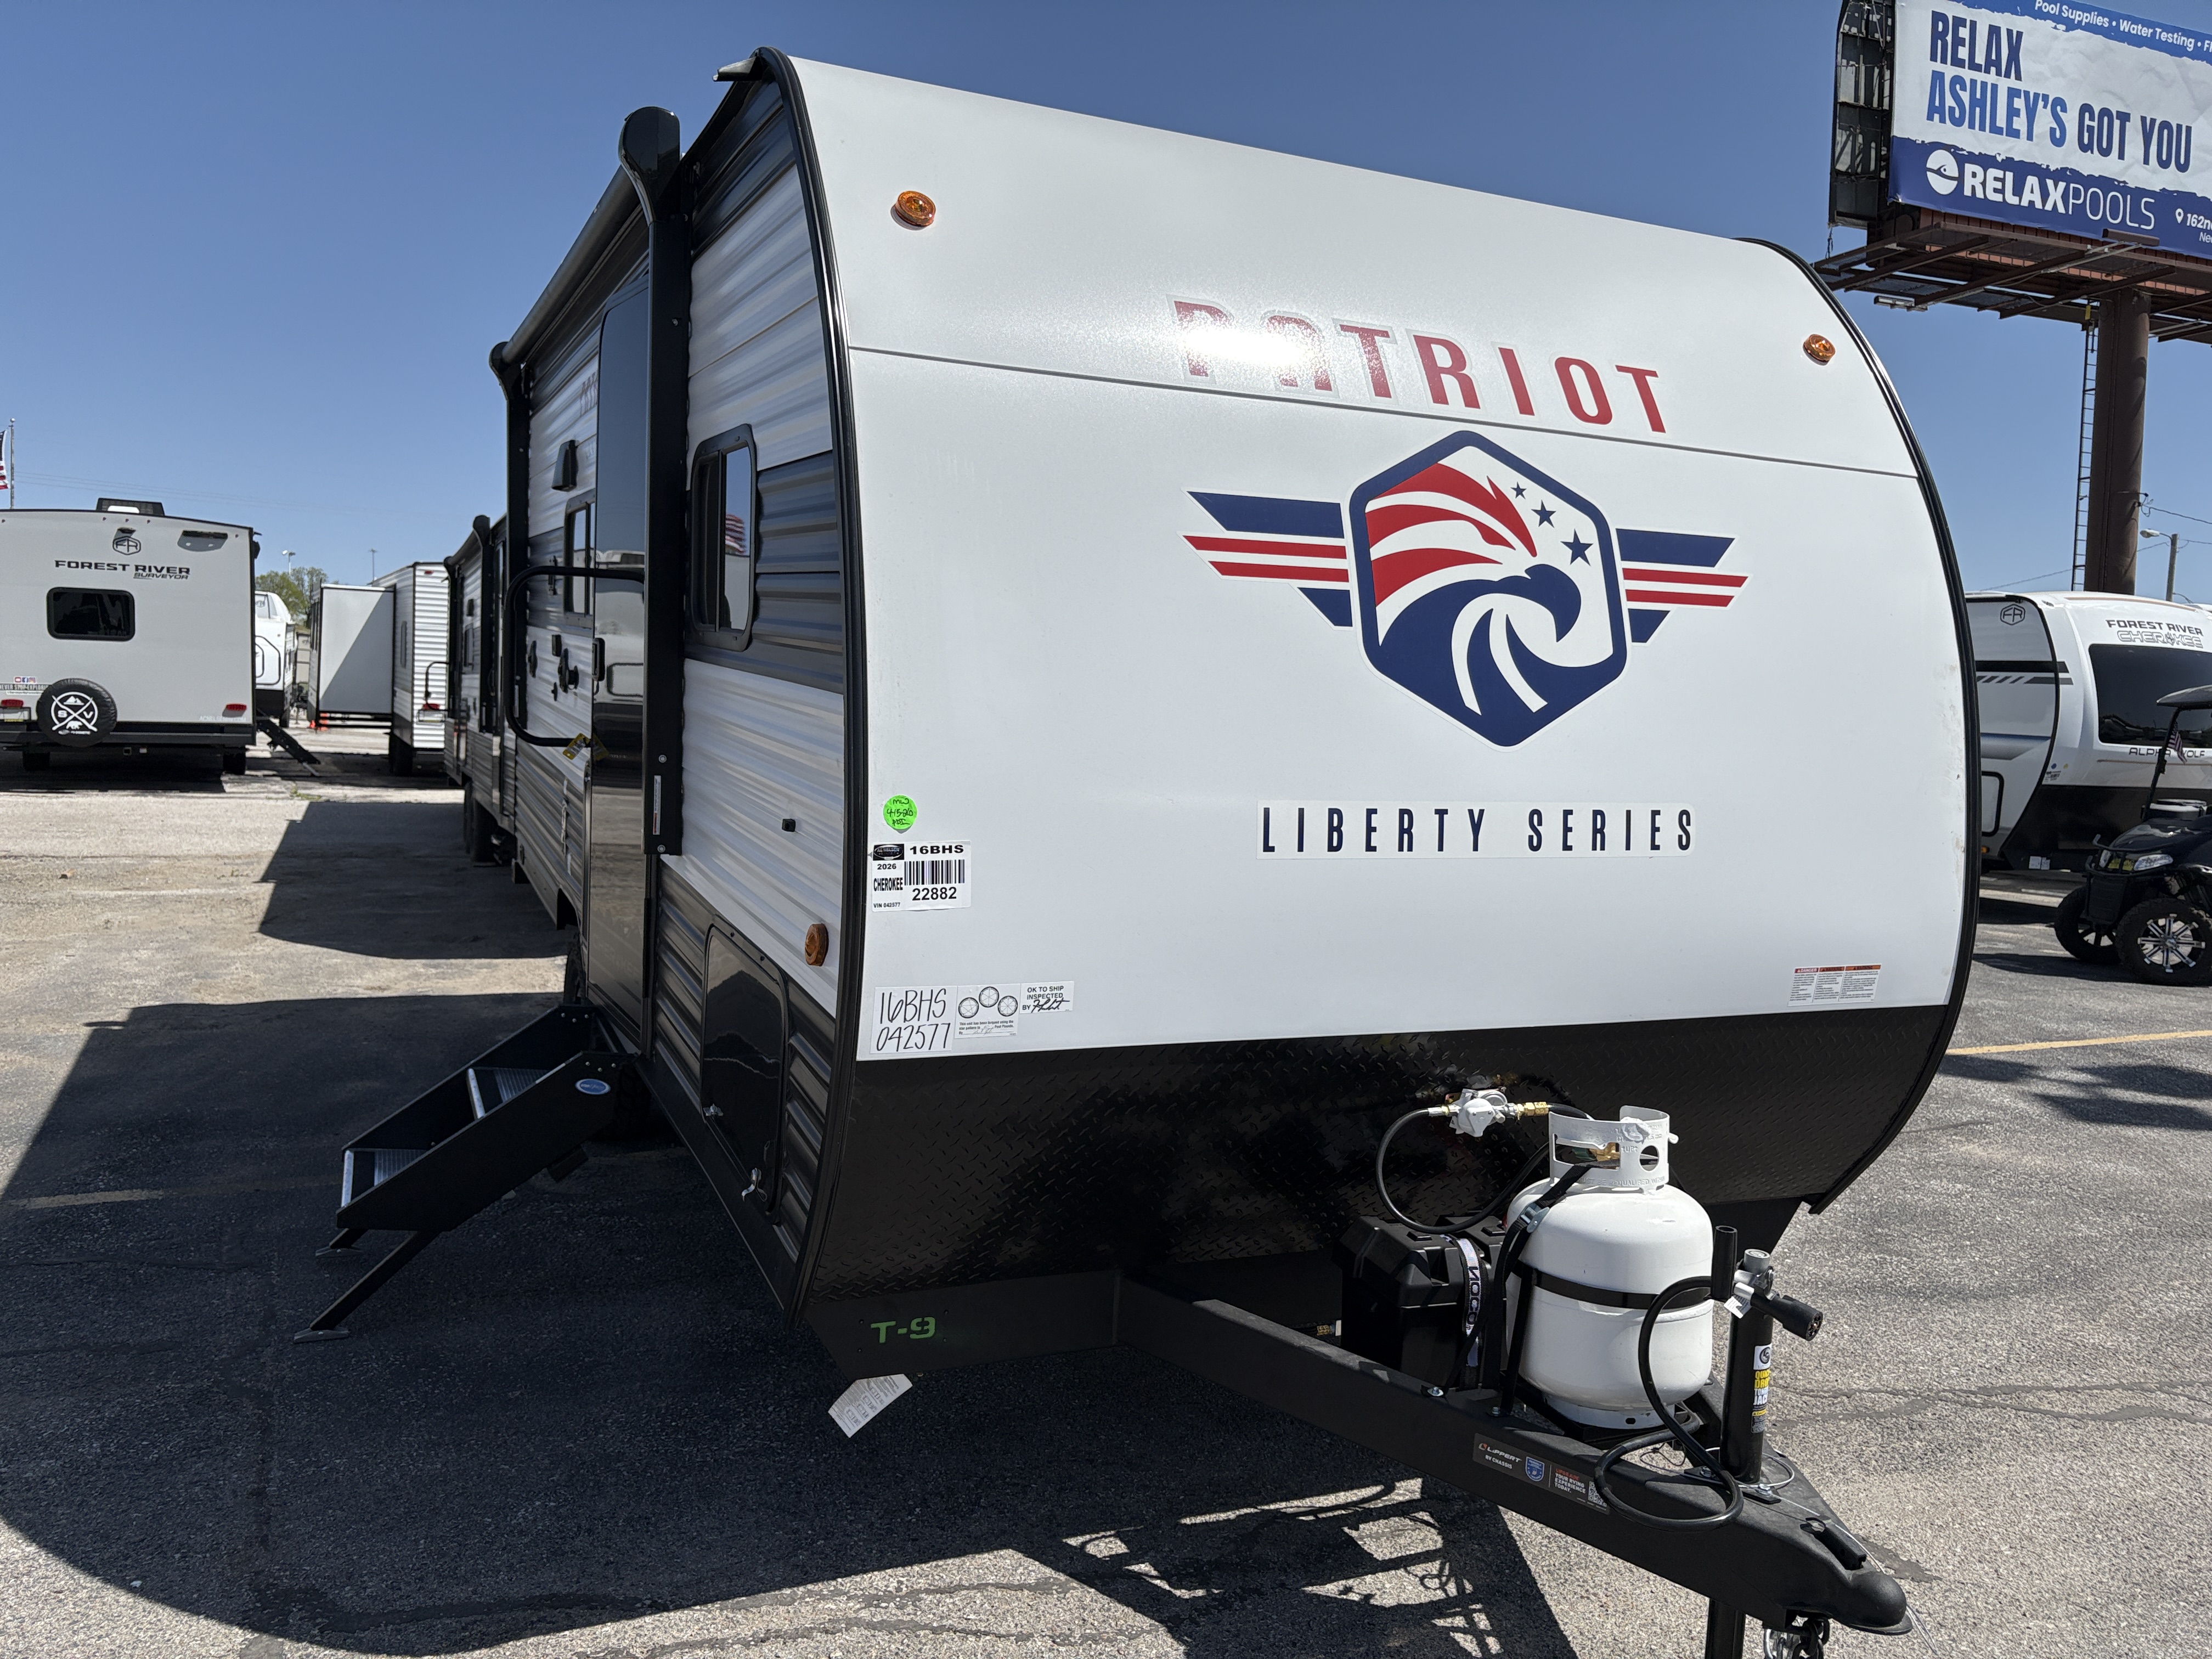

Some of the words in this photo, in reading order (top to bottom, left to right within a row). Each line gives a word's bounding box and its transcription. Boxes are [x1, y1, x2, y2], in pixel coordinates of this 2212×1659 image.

[2035, 0, 2060, 15] Pool
[2061, 5, 2109, 27] Supplies
[2119, 19, 2153, 38] Water
[2155, 27, 2195, 52] Testing
[1929, 10, 2023, 81] RELAX
[1926, 70, 2068, 148] ASHLEY'S
[2077, 103, 2131, 161] GOT
[2140, 115, 2193, 173] YOU
[2186, 213, 2212, 230] 162n
[55, 560, 130, 571] FOREST
[134, 565, 190, 575] RIVER
[2106, 620, 2163, 630] FOREST
[2165, 623, 2204, 637] RIVER
[2183, 749, 2205, 758] OLF
[1262, 806, 1485, 853] LIBERTY
[1528, 808, 1691, 852] SERIES
[910, 845, 964, 855] 16BHS
[873, 877, 904, 891] CHEROKEE
[912, 887, 957, 901] 22882
[880, 988, 946, 1024] 16BHS
[876, 1023, 951, 1052] 042577
[870, 1317, 936, 1344] T-9
[1754, 1378, 1769, 1389] DRO
[1492, 1457, 1513, 1469] CHASSIS
[1555, 1472, 1568, 1482] YOUR
[1569, 1478, 1585, 1488] RVING
[1555, 1477, 1586, 1494] EXPERIENCE
